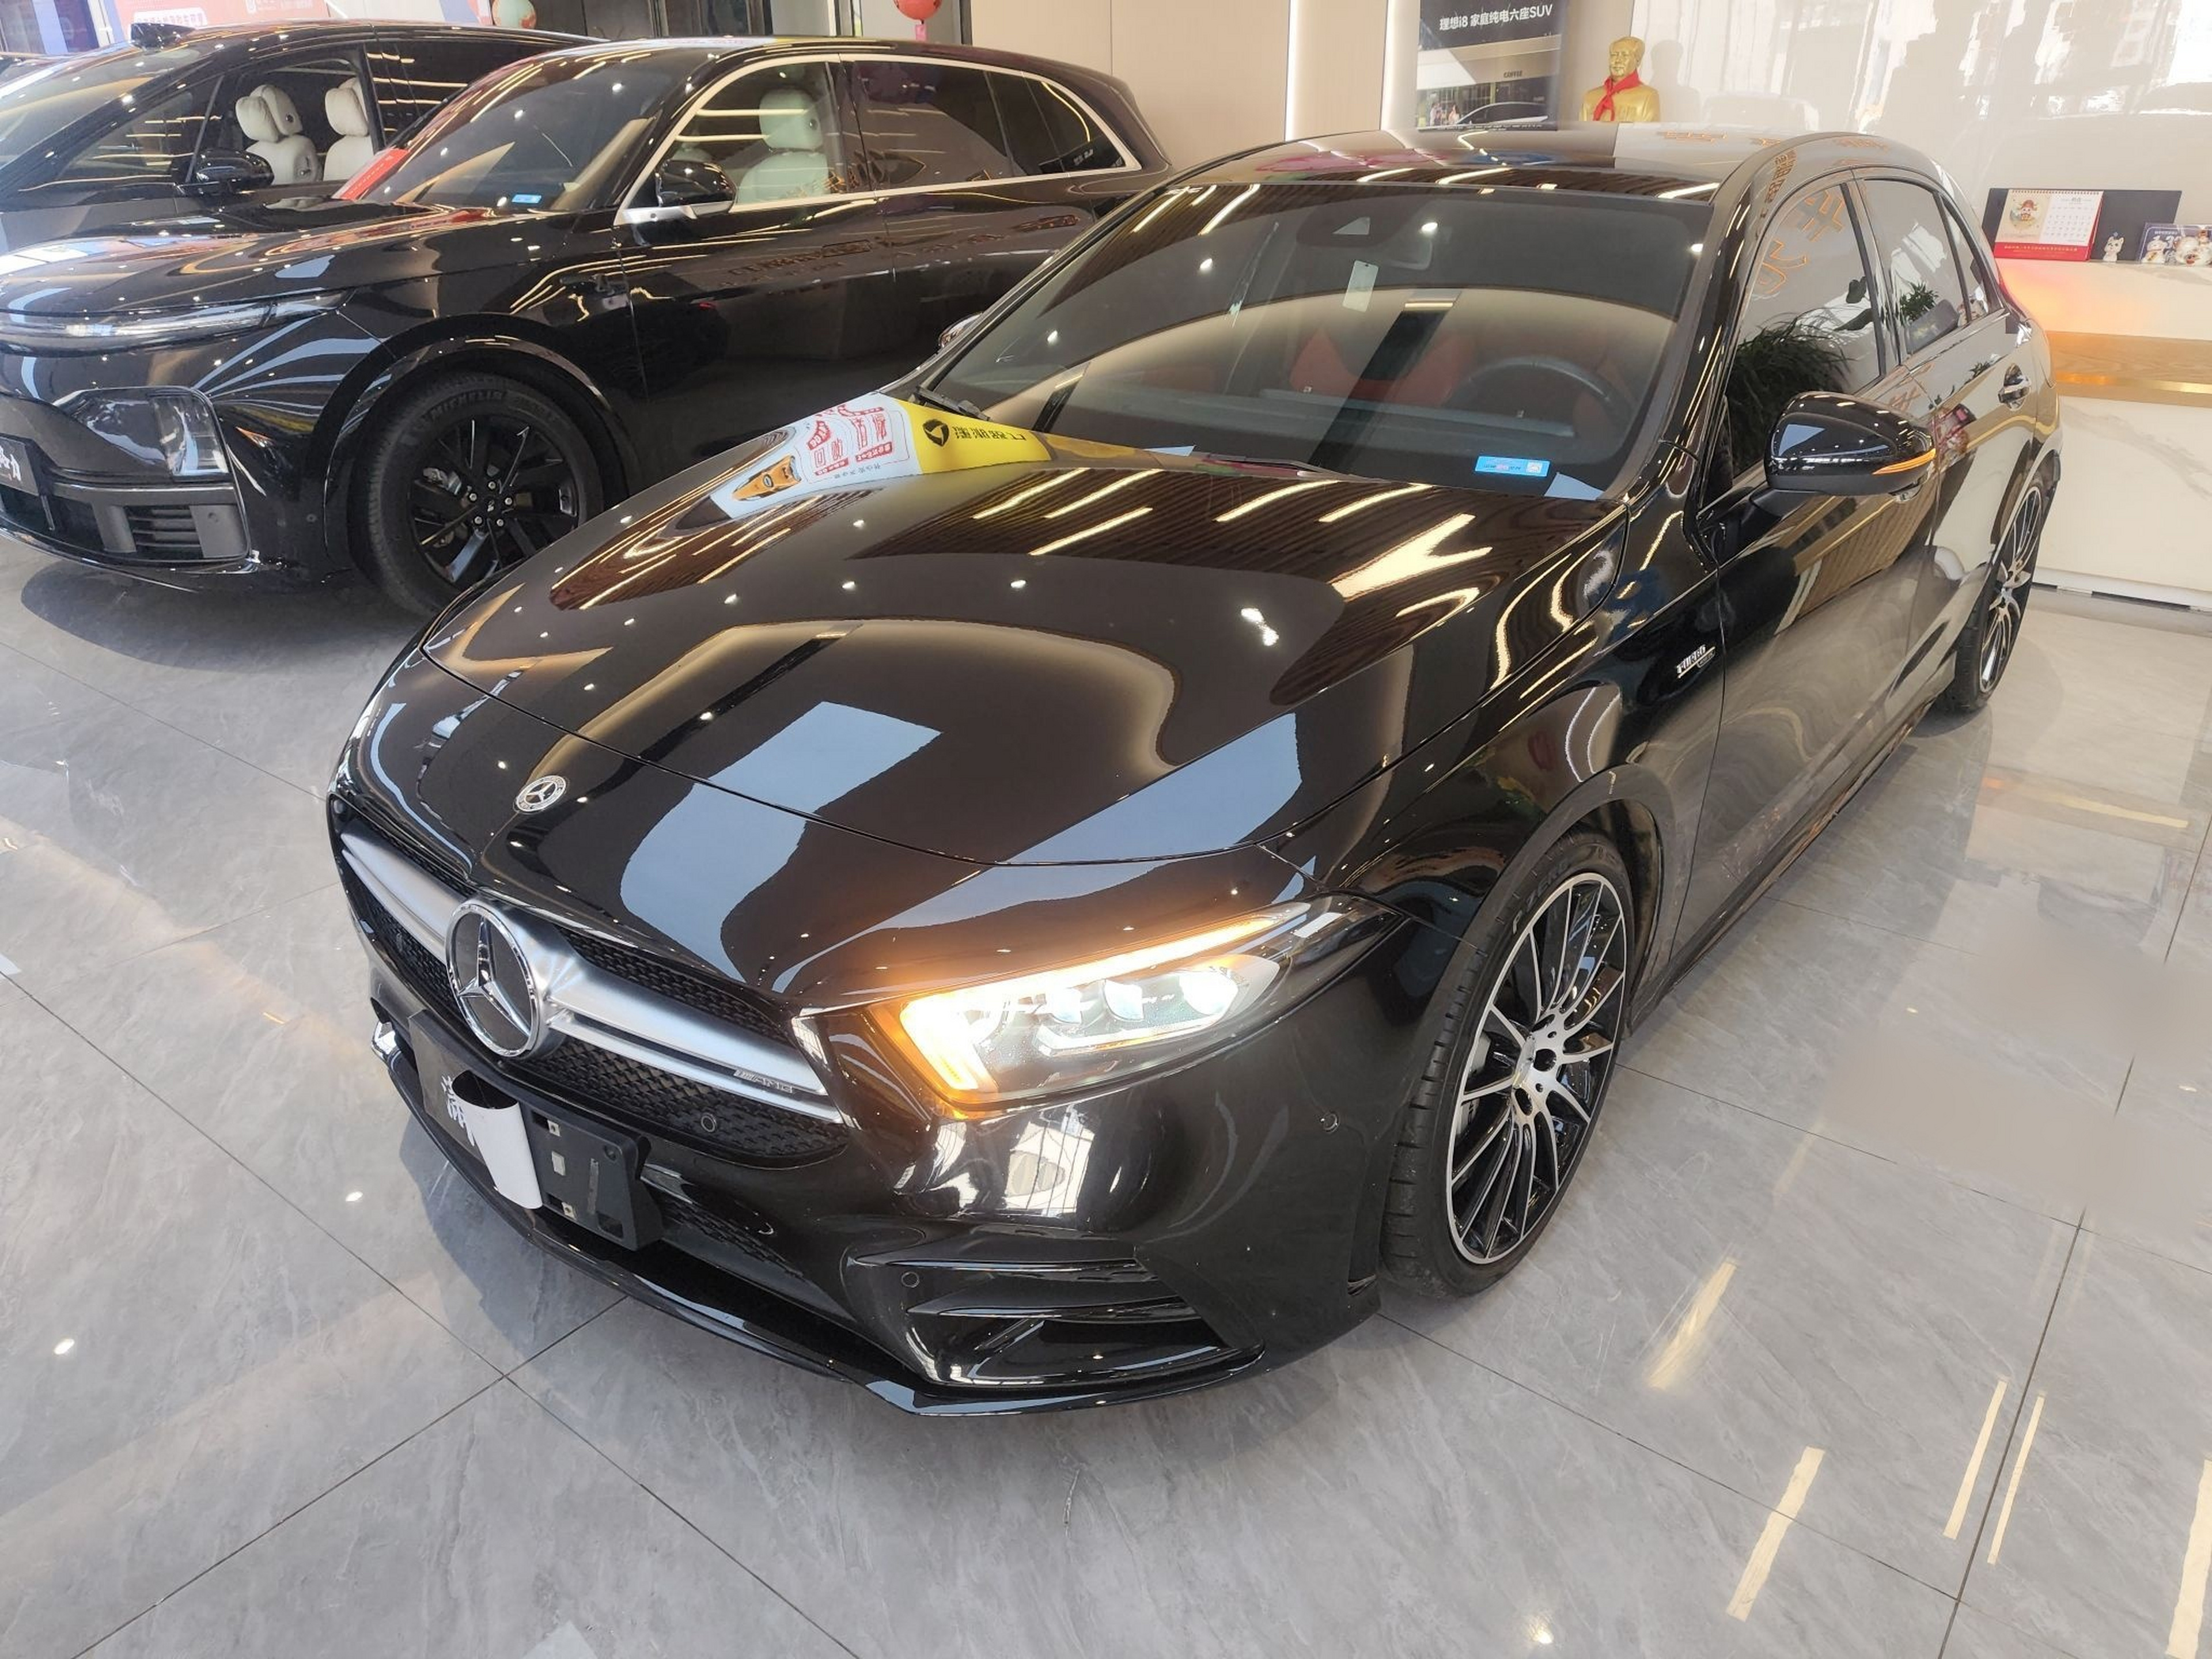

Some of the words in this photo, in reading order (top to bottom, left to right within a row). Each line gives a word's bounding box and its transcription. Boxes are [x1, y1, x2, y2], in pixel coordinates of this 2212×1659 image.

[1439, 16, 1468, 31] 理想i8
[1470, 4, 1553, 26] 家庭纯电六座SUV
[1676, 645, 1706, 673] TURBO
[754, 1077, 793, 1093] AMG
